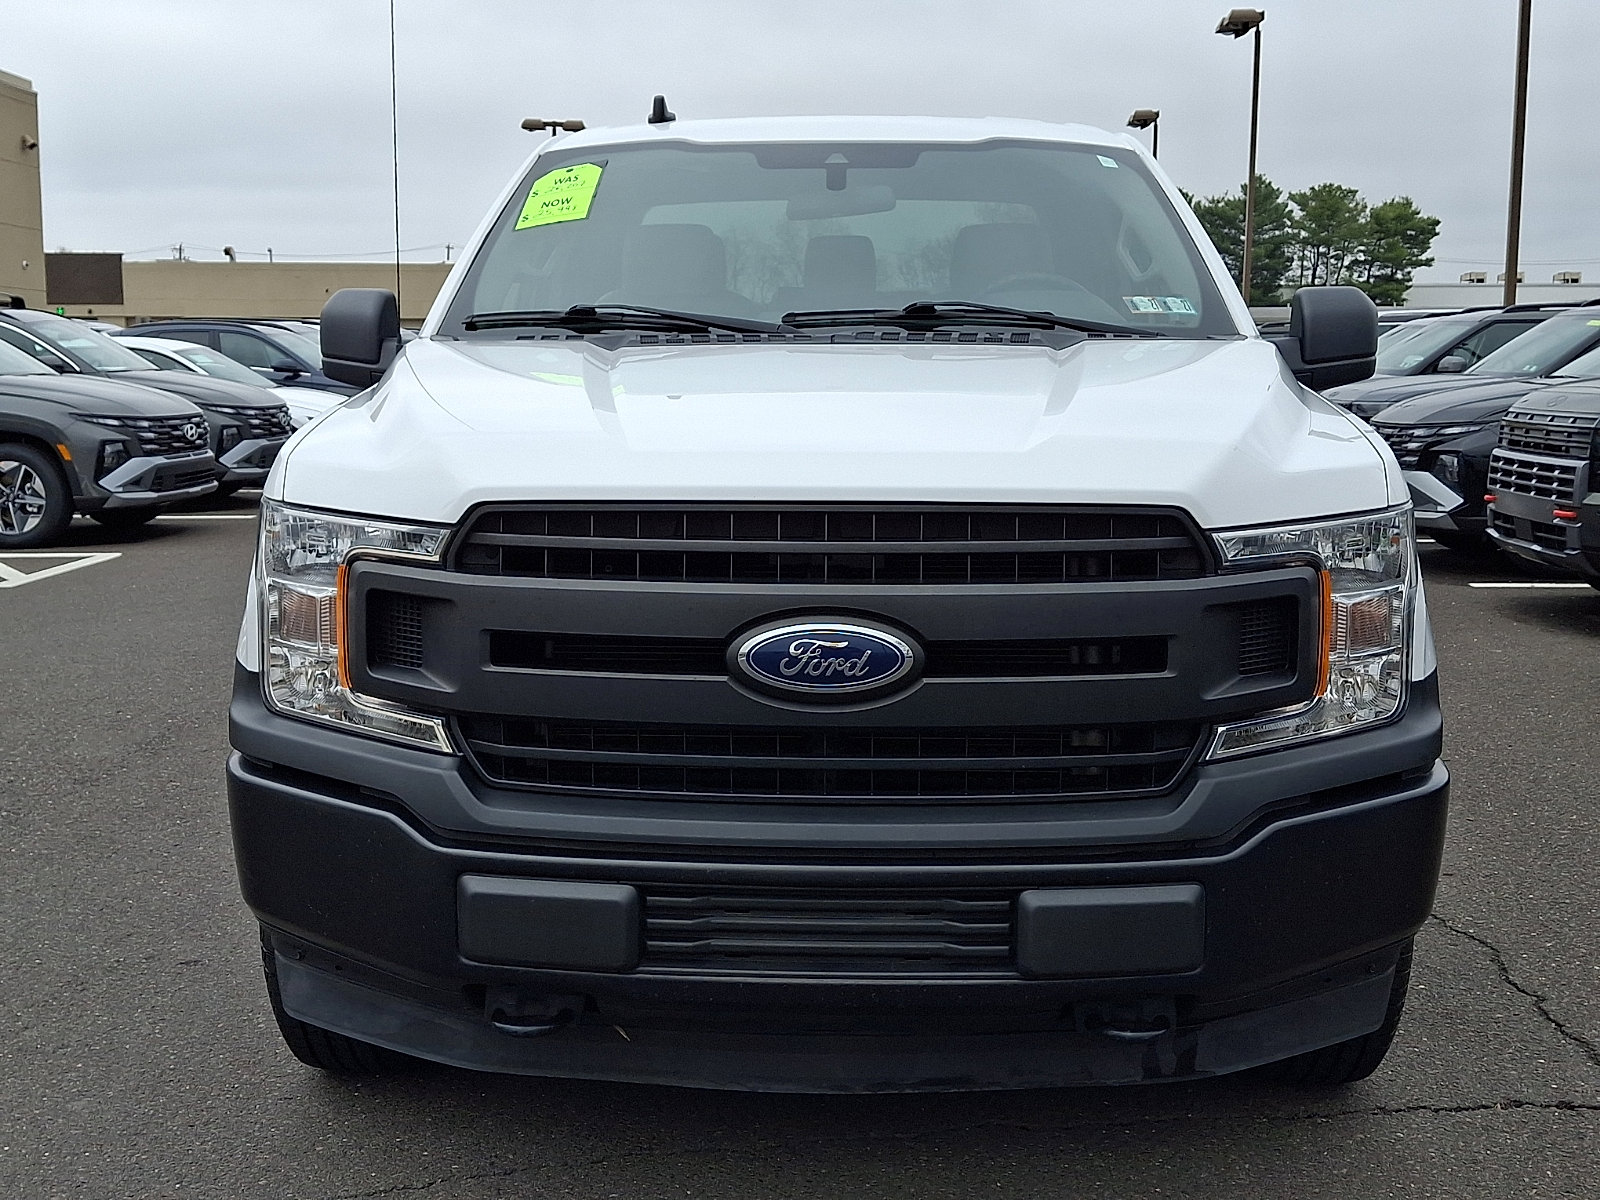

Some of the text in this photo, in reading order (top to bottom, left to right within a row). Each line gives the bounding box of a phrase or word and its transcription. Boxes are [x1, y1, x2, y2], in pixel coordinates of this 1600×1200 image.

[554, 175, 579, 185] WAS
[541, 197, 573, 208] NOW
[779, 638, 872, 676] Ford
